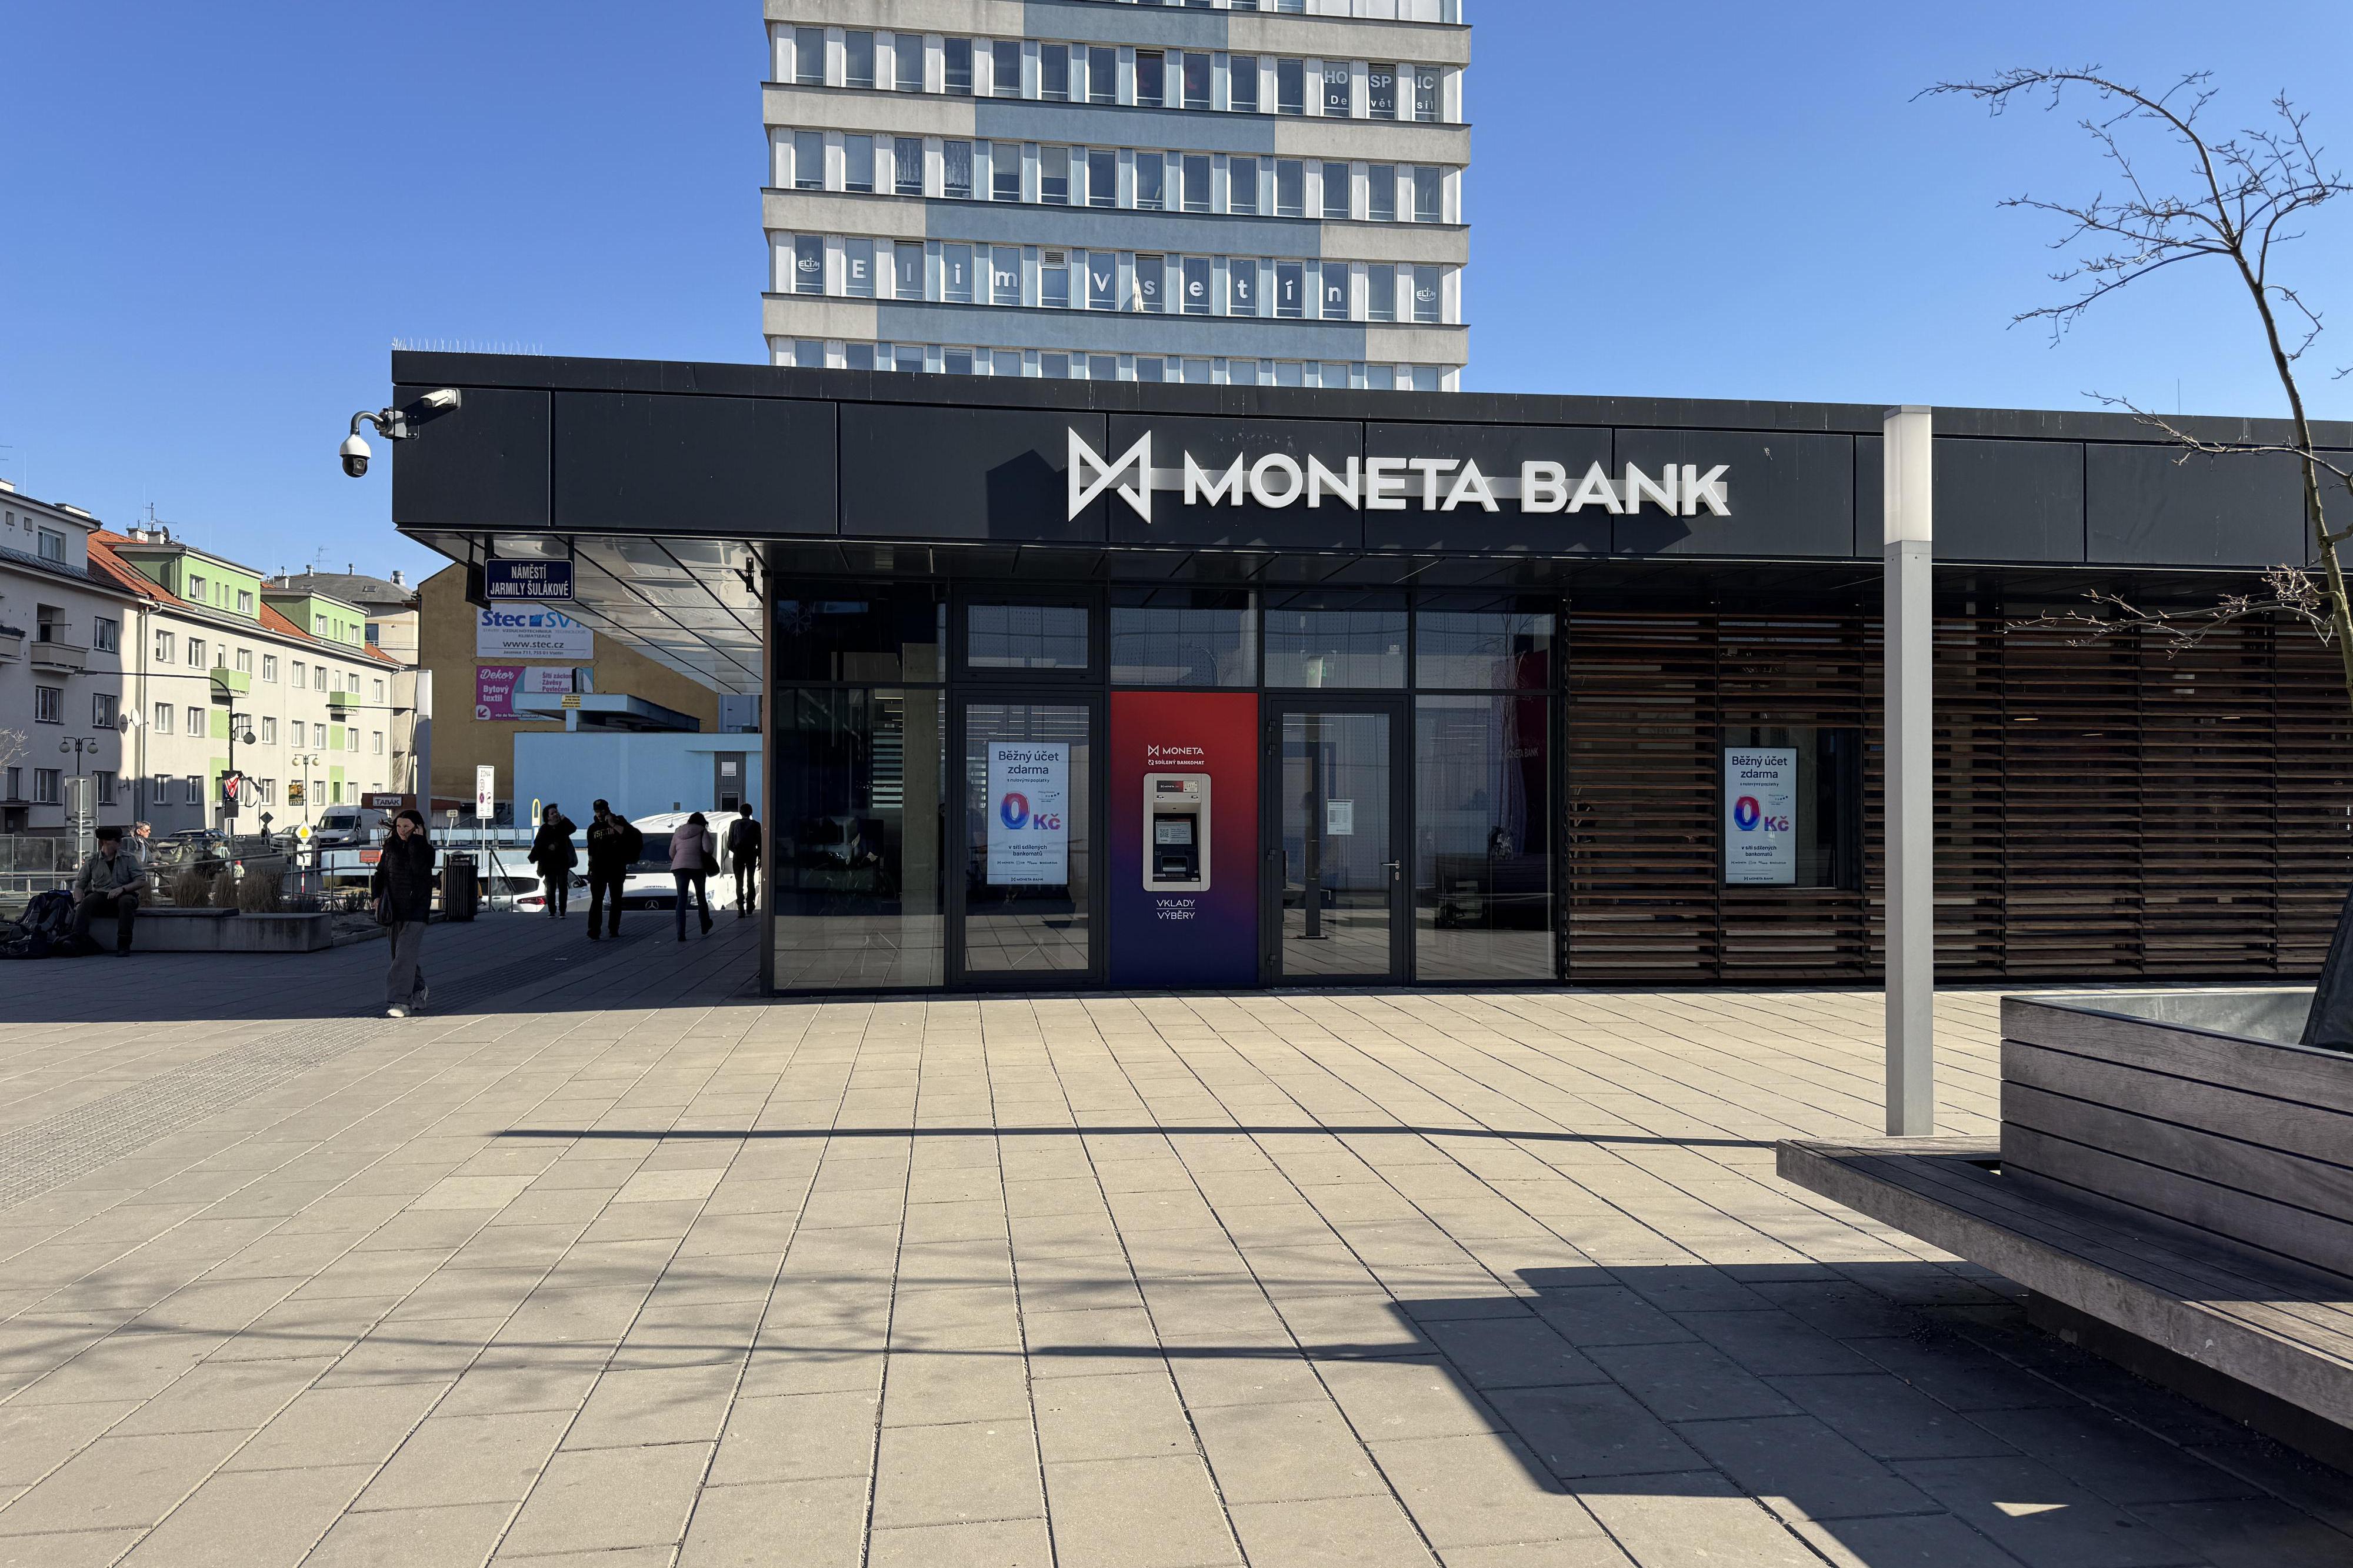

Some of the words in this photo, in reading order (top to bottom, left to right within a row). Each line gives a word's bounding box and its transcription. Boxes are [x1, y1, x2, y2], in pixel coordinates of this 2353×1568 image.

[1184, 449, 1500, 512] MONETA
[1521, 460, 1732, 517] BANK
[511, 563, 547, 579] NÁMĚSTÍ
[490, 582, 525, 595] JARMILY
[527, 580, 569, 596] ŠULÁKOVÉ
[481, 610, 526, 627] Stec
[545, 612, 581, 628] SV
[480, 669, 514, 679] Dekor
[483, 685, 509, 694] Bytový
[998, 750, 1032, 763] Běžný
[1034, 750, 1059, 761] účet
[1524, 747, 1539, 758] BANK
[1732, 755, 1763, 768] Běžný
[1765, 756, 1788, 766] účet
[1008, 765, 1049, 775] zdarma
[1741, 769, 1778, 778] zdarma
[1000, 791, 1030, 830] 0
[1034, 813, 1061, 830] Kč
[1734, 795, 1761, 831] 0
[1764, 816, 1789, 831] Kč
[1157, 910, 1195, 920] VÝBĚRY
